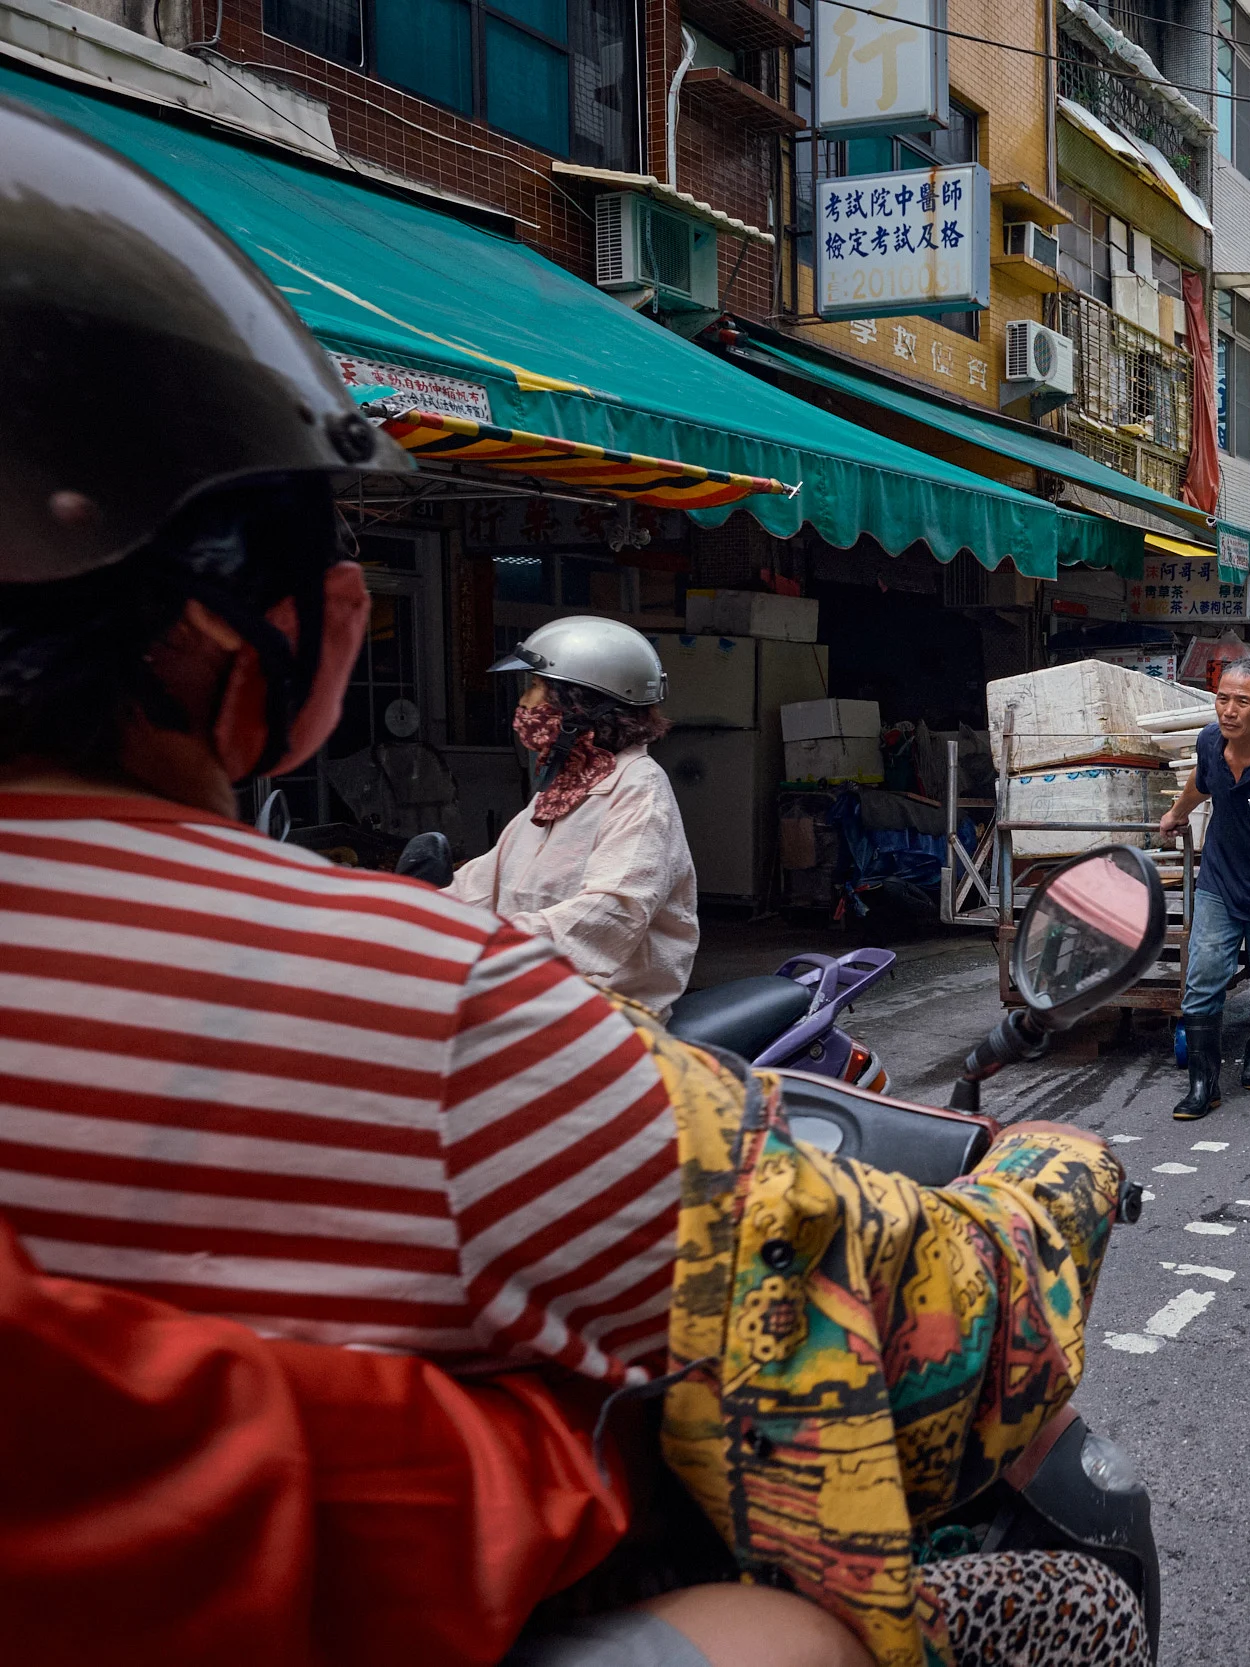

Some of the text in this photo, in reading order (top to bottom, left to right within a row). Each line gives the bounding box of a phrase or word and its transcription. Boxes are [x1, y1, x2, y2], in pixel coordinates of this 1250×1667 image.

[825, 179, 962, 223] 考試院中醫師
[825, 220, 965, 260] 檢定考試及格
